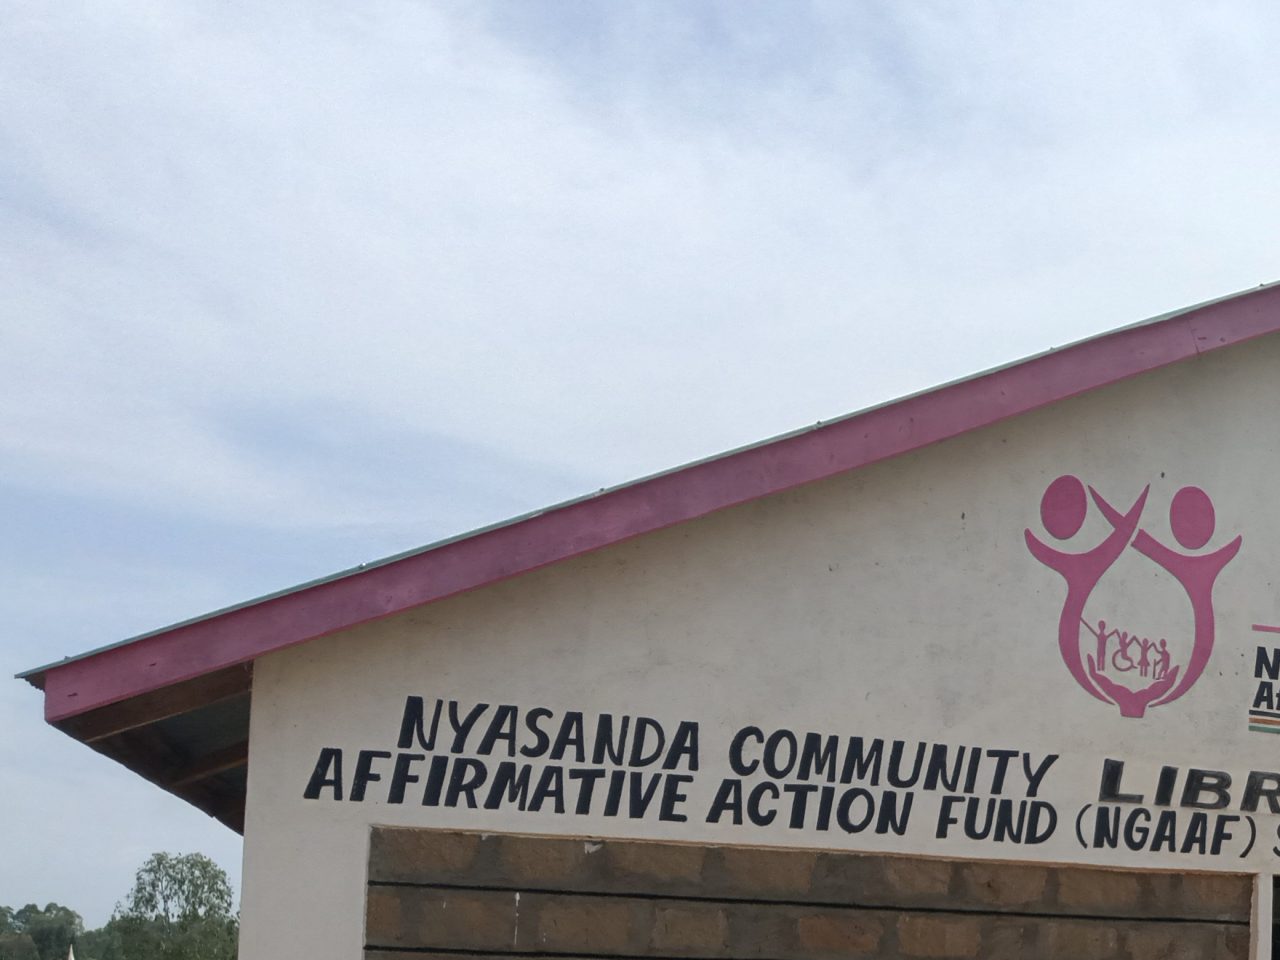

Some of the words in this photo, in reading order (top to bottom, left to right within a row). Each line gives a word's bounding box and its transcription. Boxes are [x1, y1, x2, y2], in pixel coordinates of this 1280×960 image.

[397, 695, 700, 772] NYASANDA
[728, 726, 1059, 797] COMMUNITY
[303, 748, 693, 822] AFFIRMATIVE
[705, 778, 914, 835] ACTION
[936, 795, 1058, 845] FUND
[1075, 803, 1257, 858] (NGAAF)
